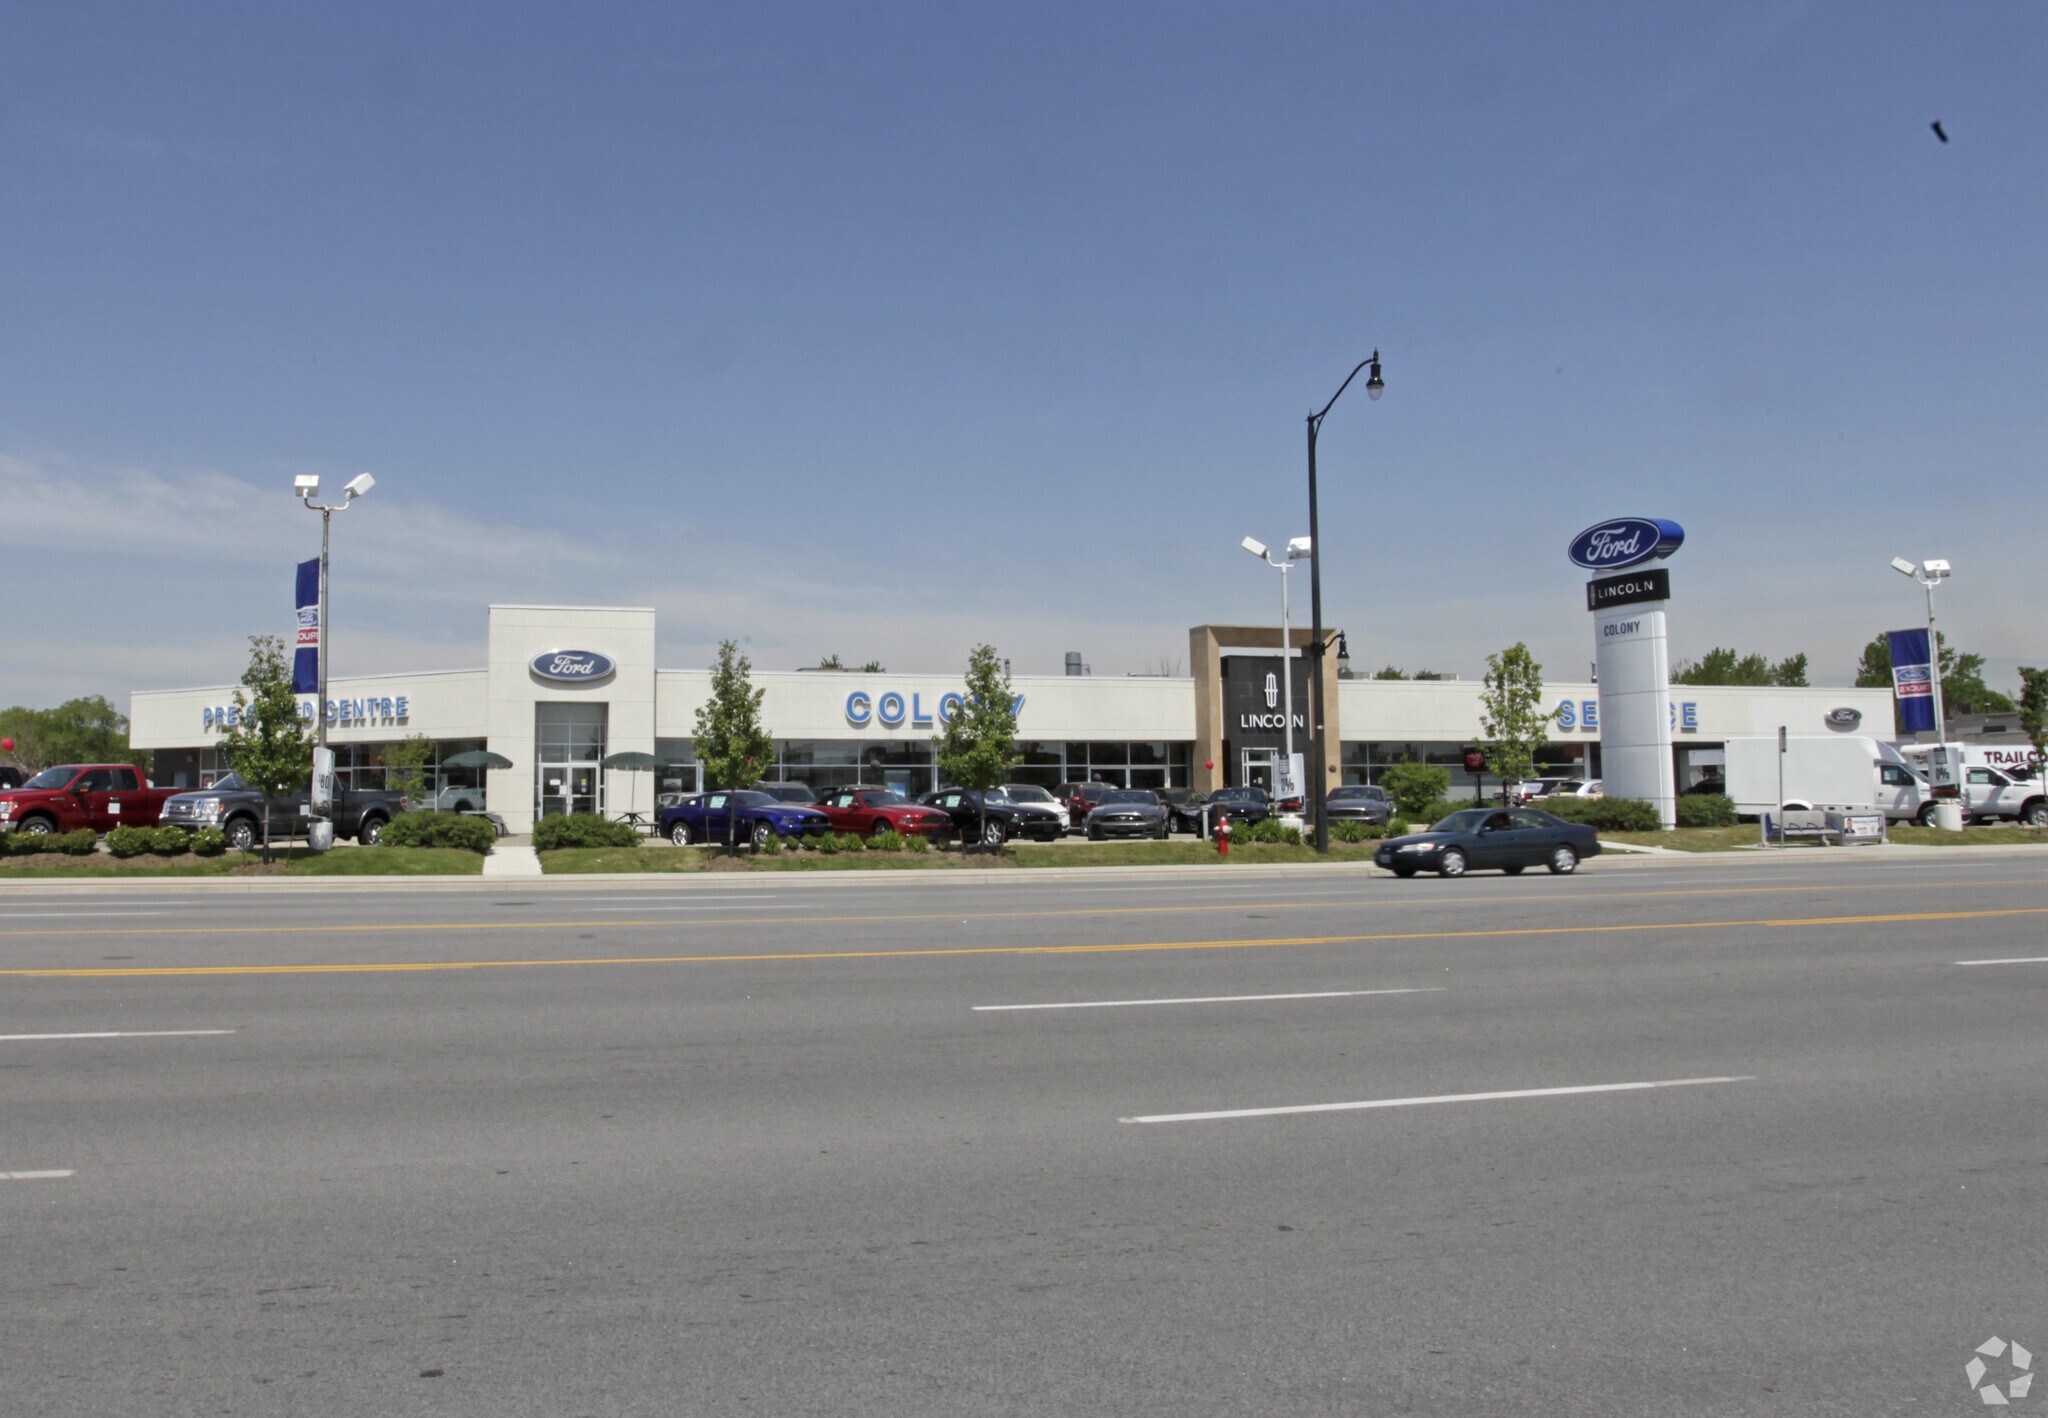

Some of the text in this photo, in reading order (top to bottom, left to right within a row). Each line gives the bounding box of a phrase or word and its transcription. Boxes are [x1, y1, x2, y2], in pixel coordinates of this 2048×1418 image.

[1586, 527, 1640, 561] Ford
[1599, 581, 1654, 598] LINCOLN
[1604, 621, 1640, 637] COLONY
[550, 655, 594, 673] Ford
[326, 696, 407, 720] CENTRE
[1241, 714, 1304, 728] LINCON
